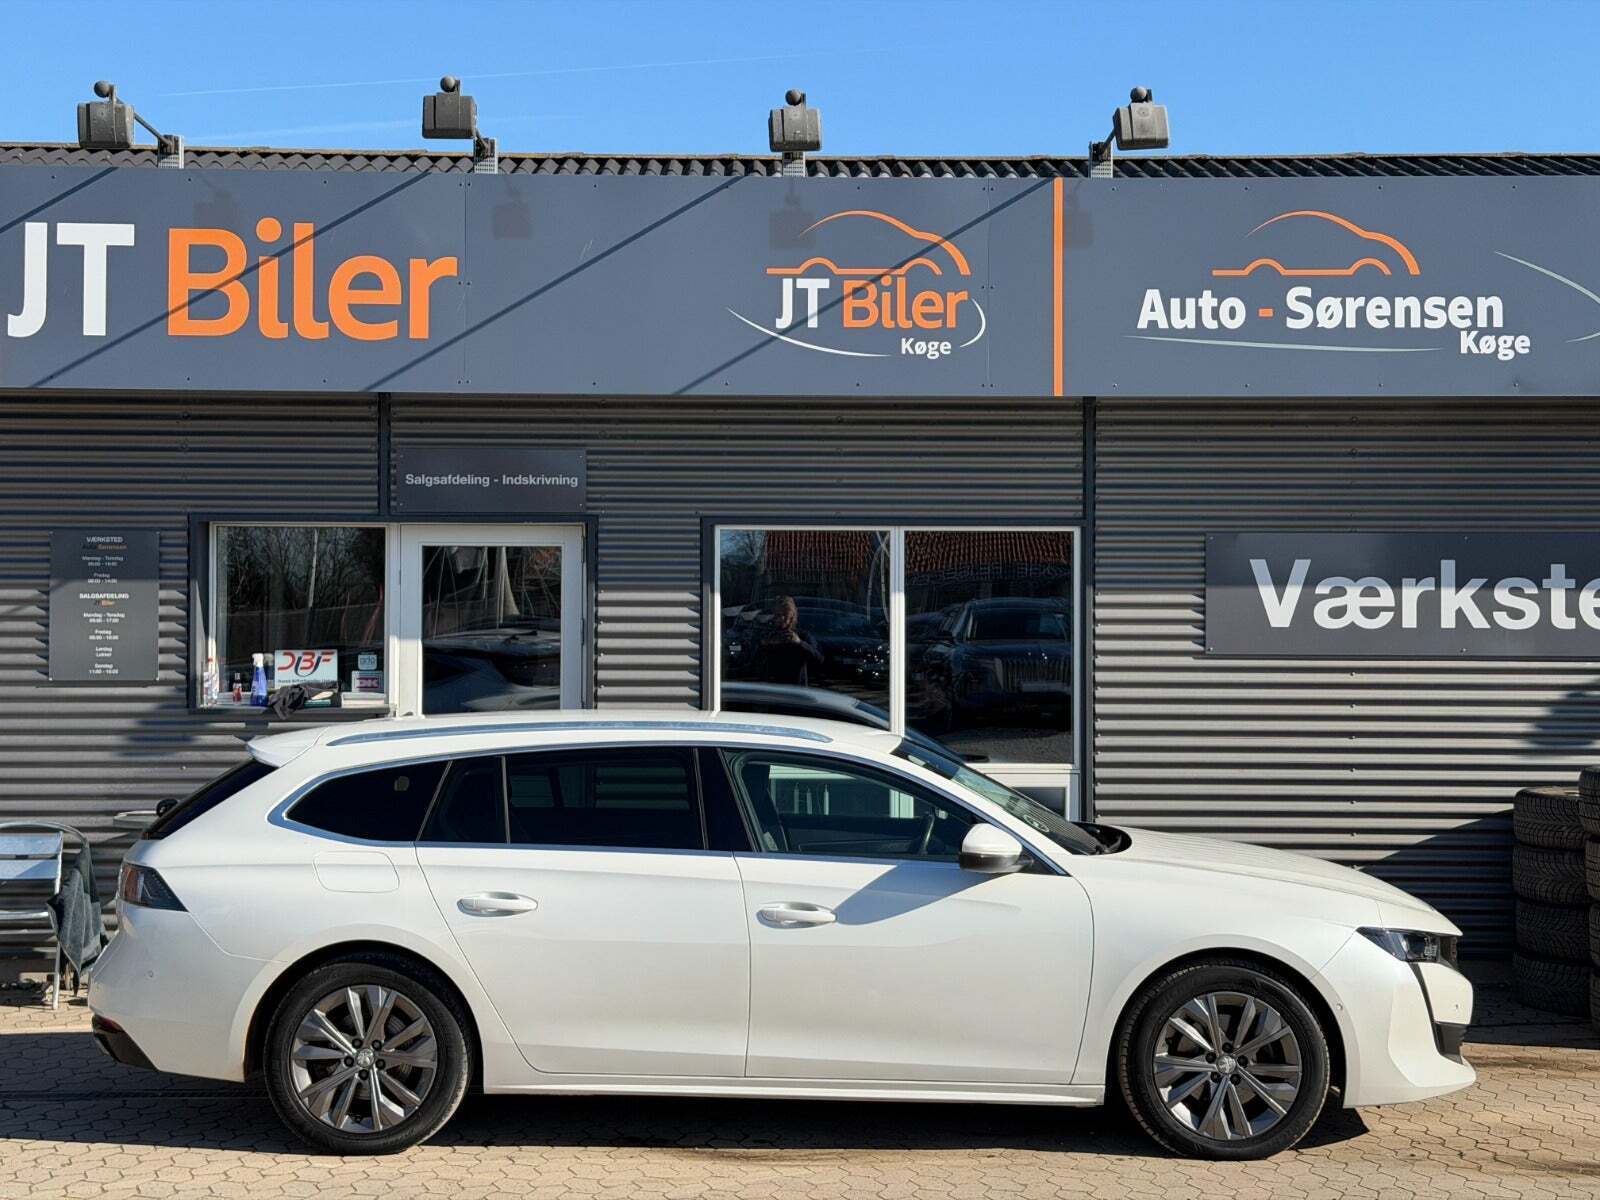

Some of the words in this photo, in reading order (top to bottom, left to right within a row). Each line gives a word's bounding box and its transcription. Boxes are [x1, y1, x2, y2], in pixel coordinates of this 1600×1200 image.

[8, 222, 134, 337] JT
[168, 218, 458, 341] Biler
[775, 278, 829, 329] JT
[843, 275, 968, 329] Biler
[1137, 288, 1245, 329] Auto
[1286, 287, 1503, 329] Sørensen
[901, 337, 951, 360] Køge
[1460, 331, 1530, 360] Køge
[405, 474, 490, 487] Salgsafdeling
[503, 474, 578, 487] Indskrivning
